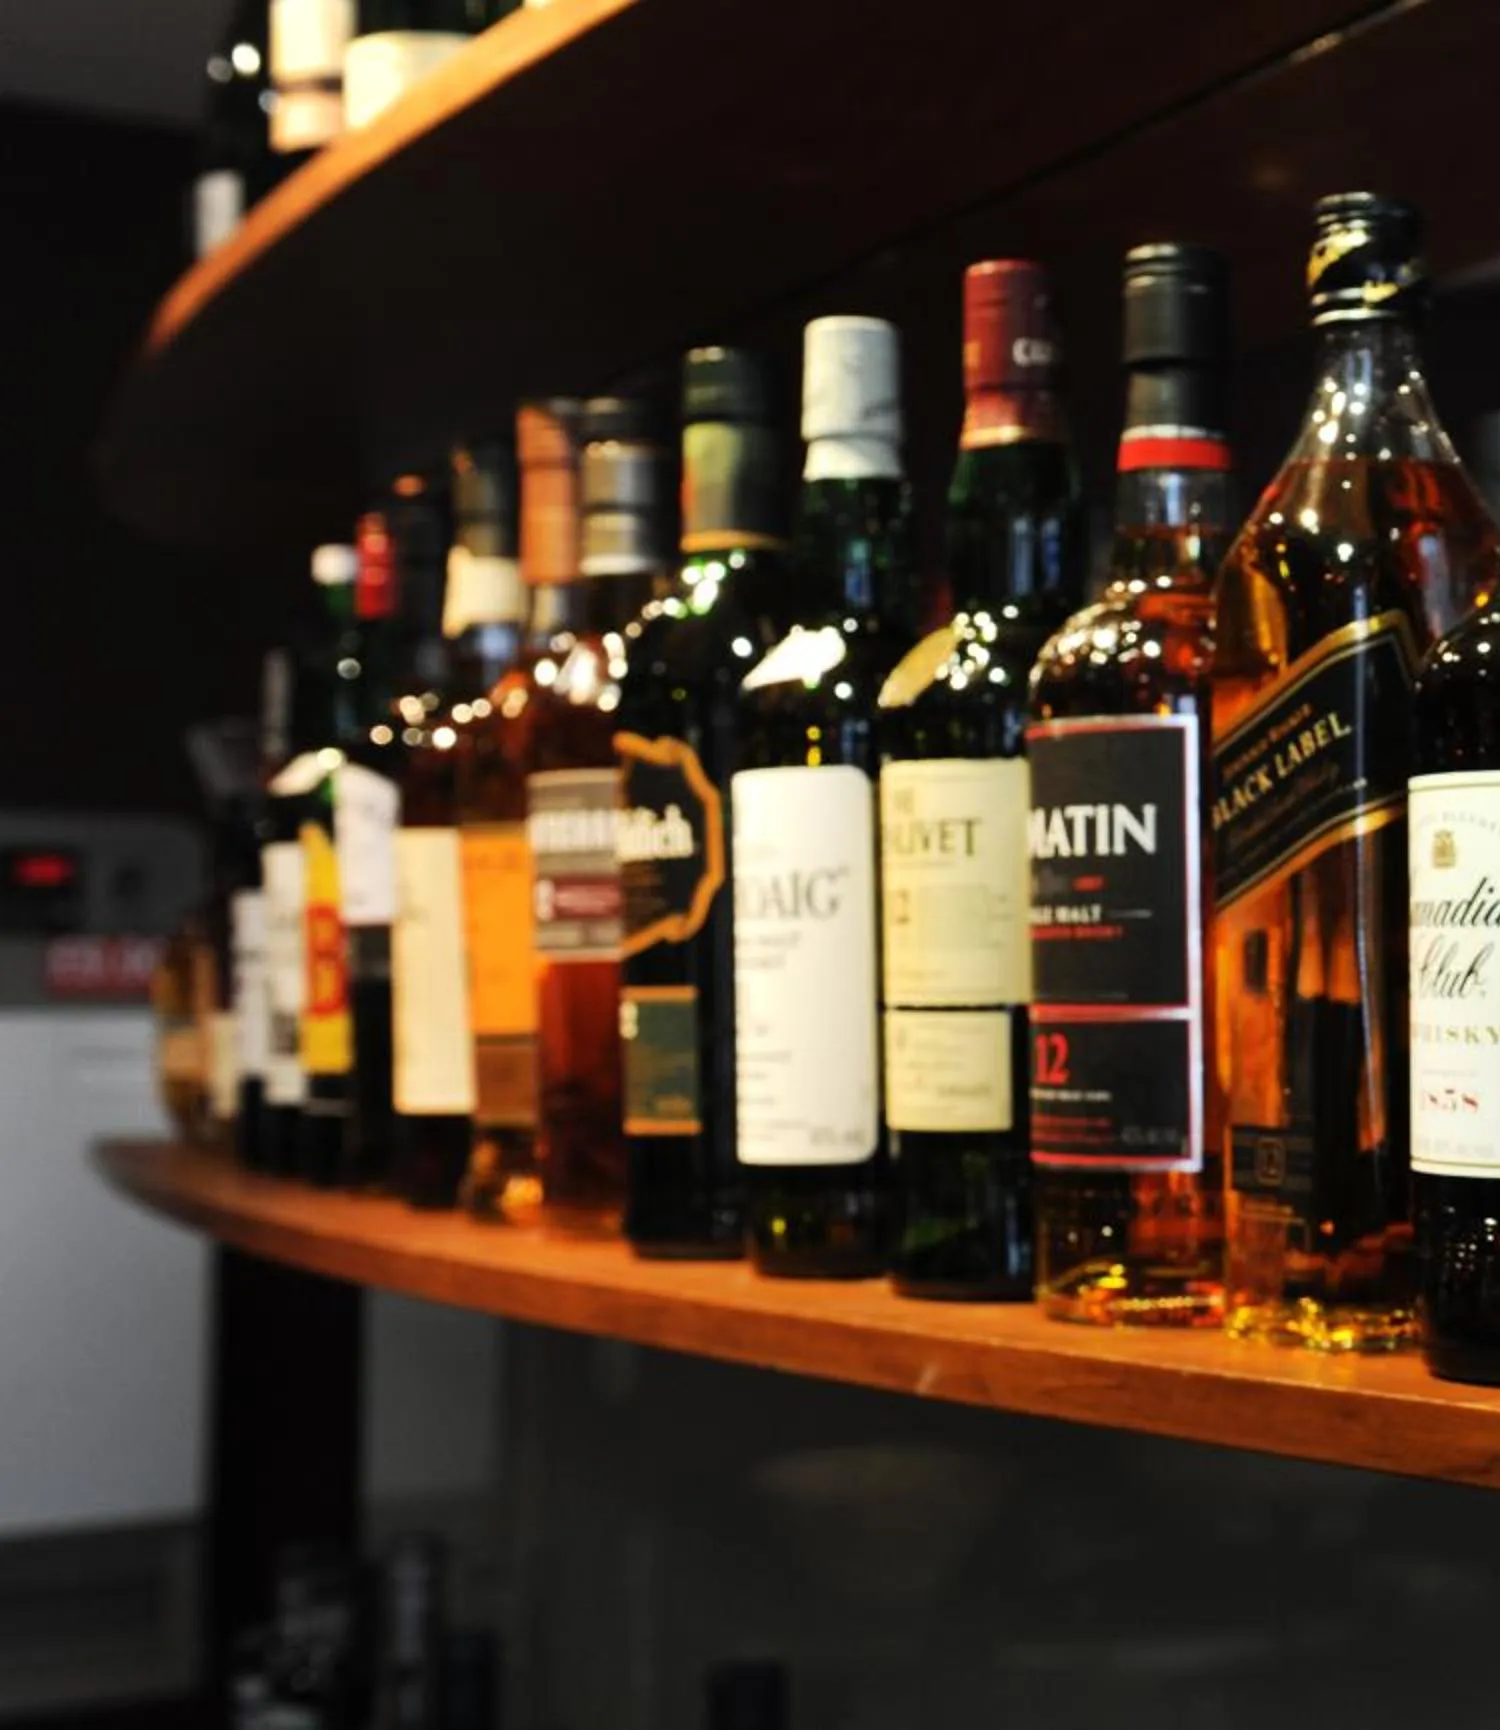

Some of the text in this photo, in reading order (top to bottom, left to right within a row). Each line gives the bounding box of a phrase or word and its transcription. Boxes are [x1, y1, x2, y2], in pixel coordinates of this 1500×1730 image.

[1211, 764, 1274, 831] BLACK
[1274, 711, 1353, 779] LABEL
[1034, 1031, 1070, 1086] 12
